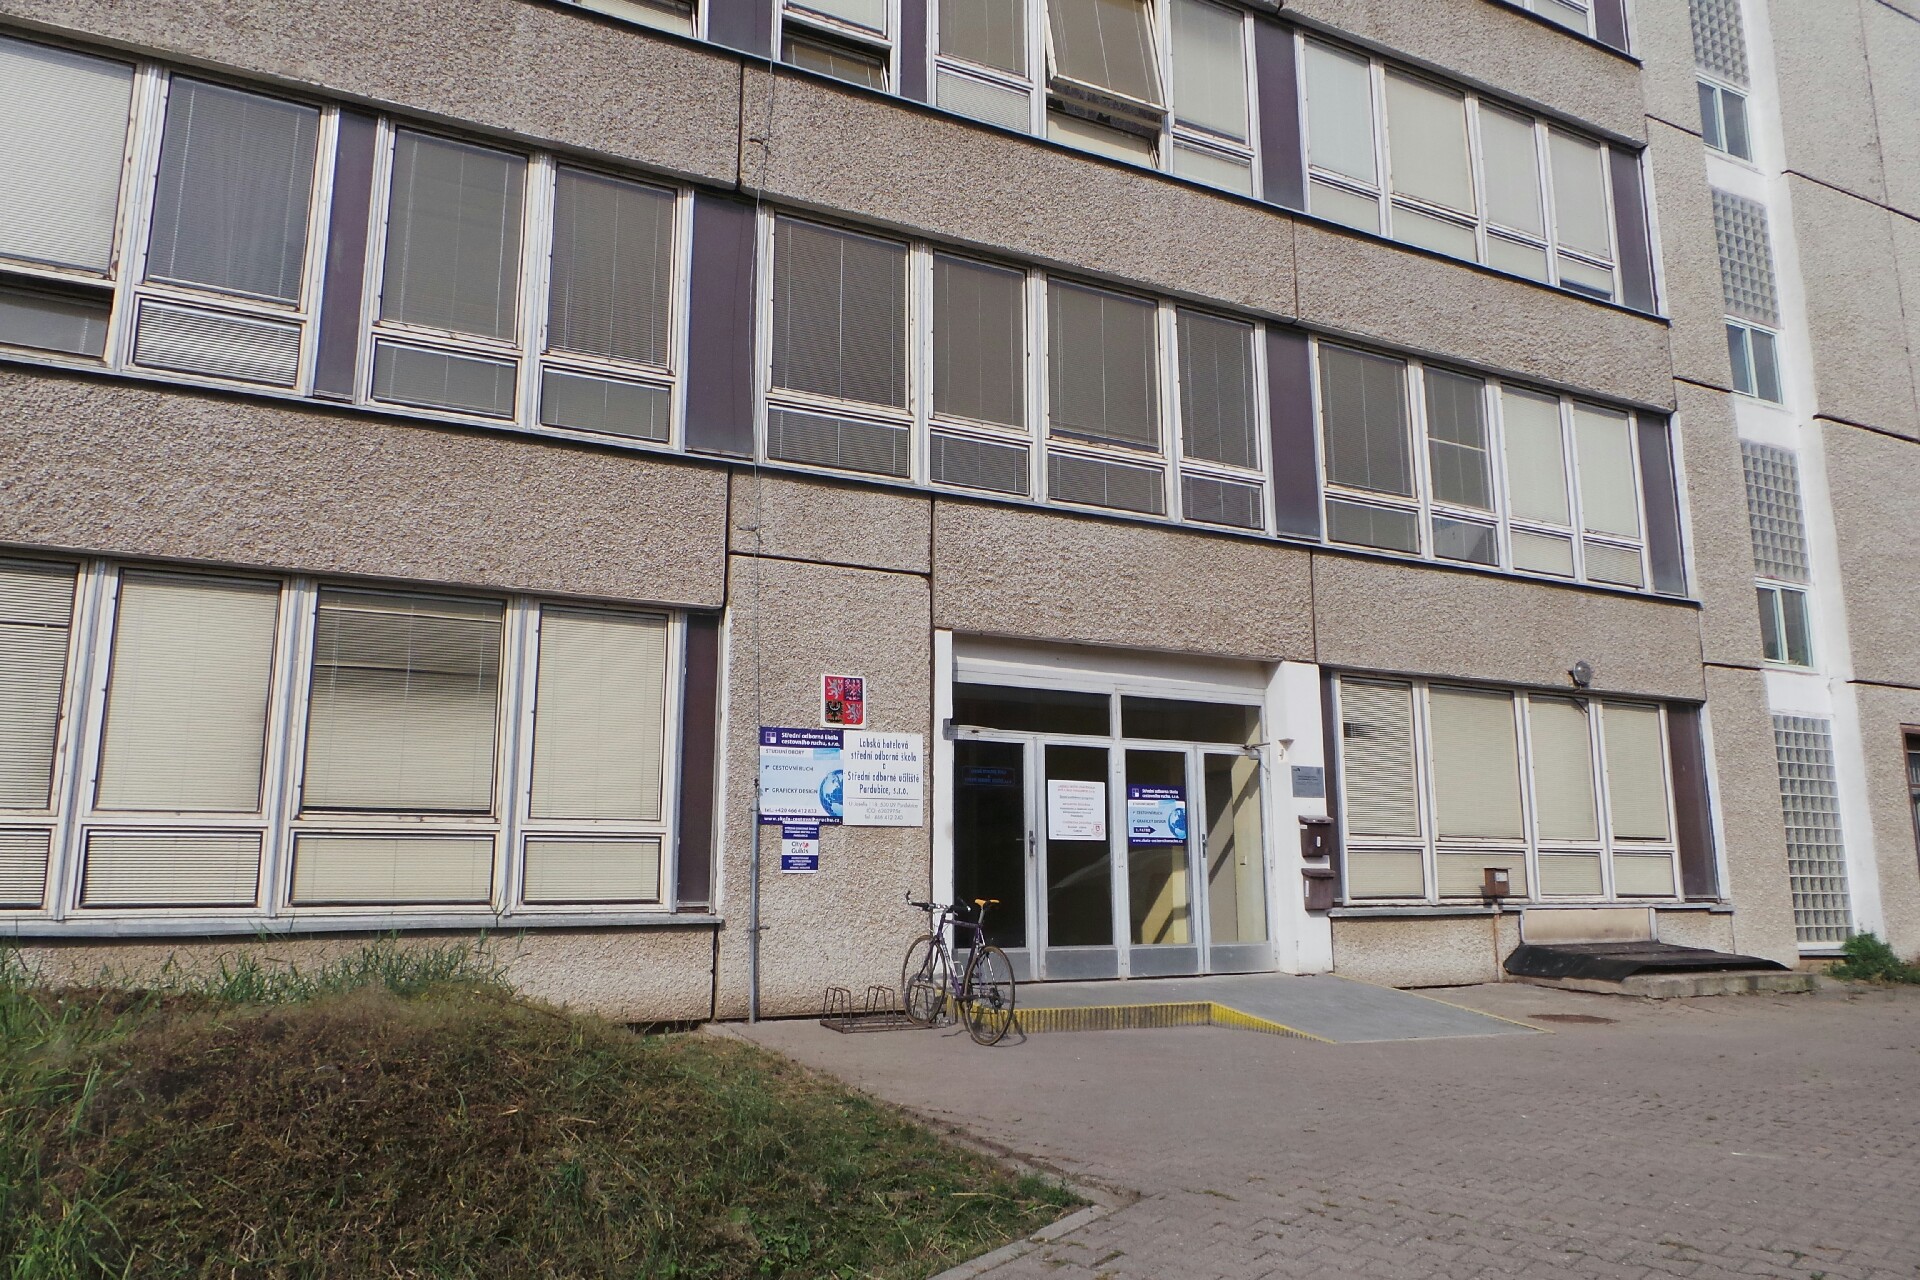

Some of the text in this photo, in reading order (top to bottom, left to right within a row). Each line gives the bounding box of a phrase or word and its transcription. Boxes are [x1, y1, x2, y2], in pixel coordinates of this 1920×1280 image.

[860, 738, 908, 749] Labská hotelová
[851, 750, 916, 762] střední odborná škola
[848, 771, 919, 783] Střední odborné učiliště
[860, 784, 891, 795] Pardubice,
